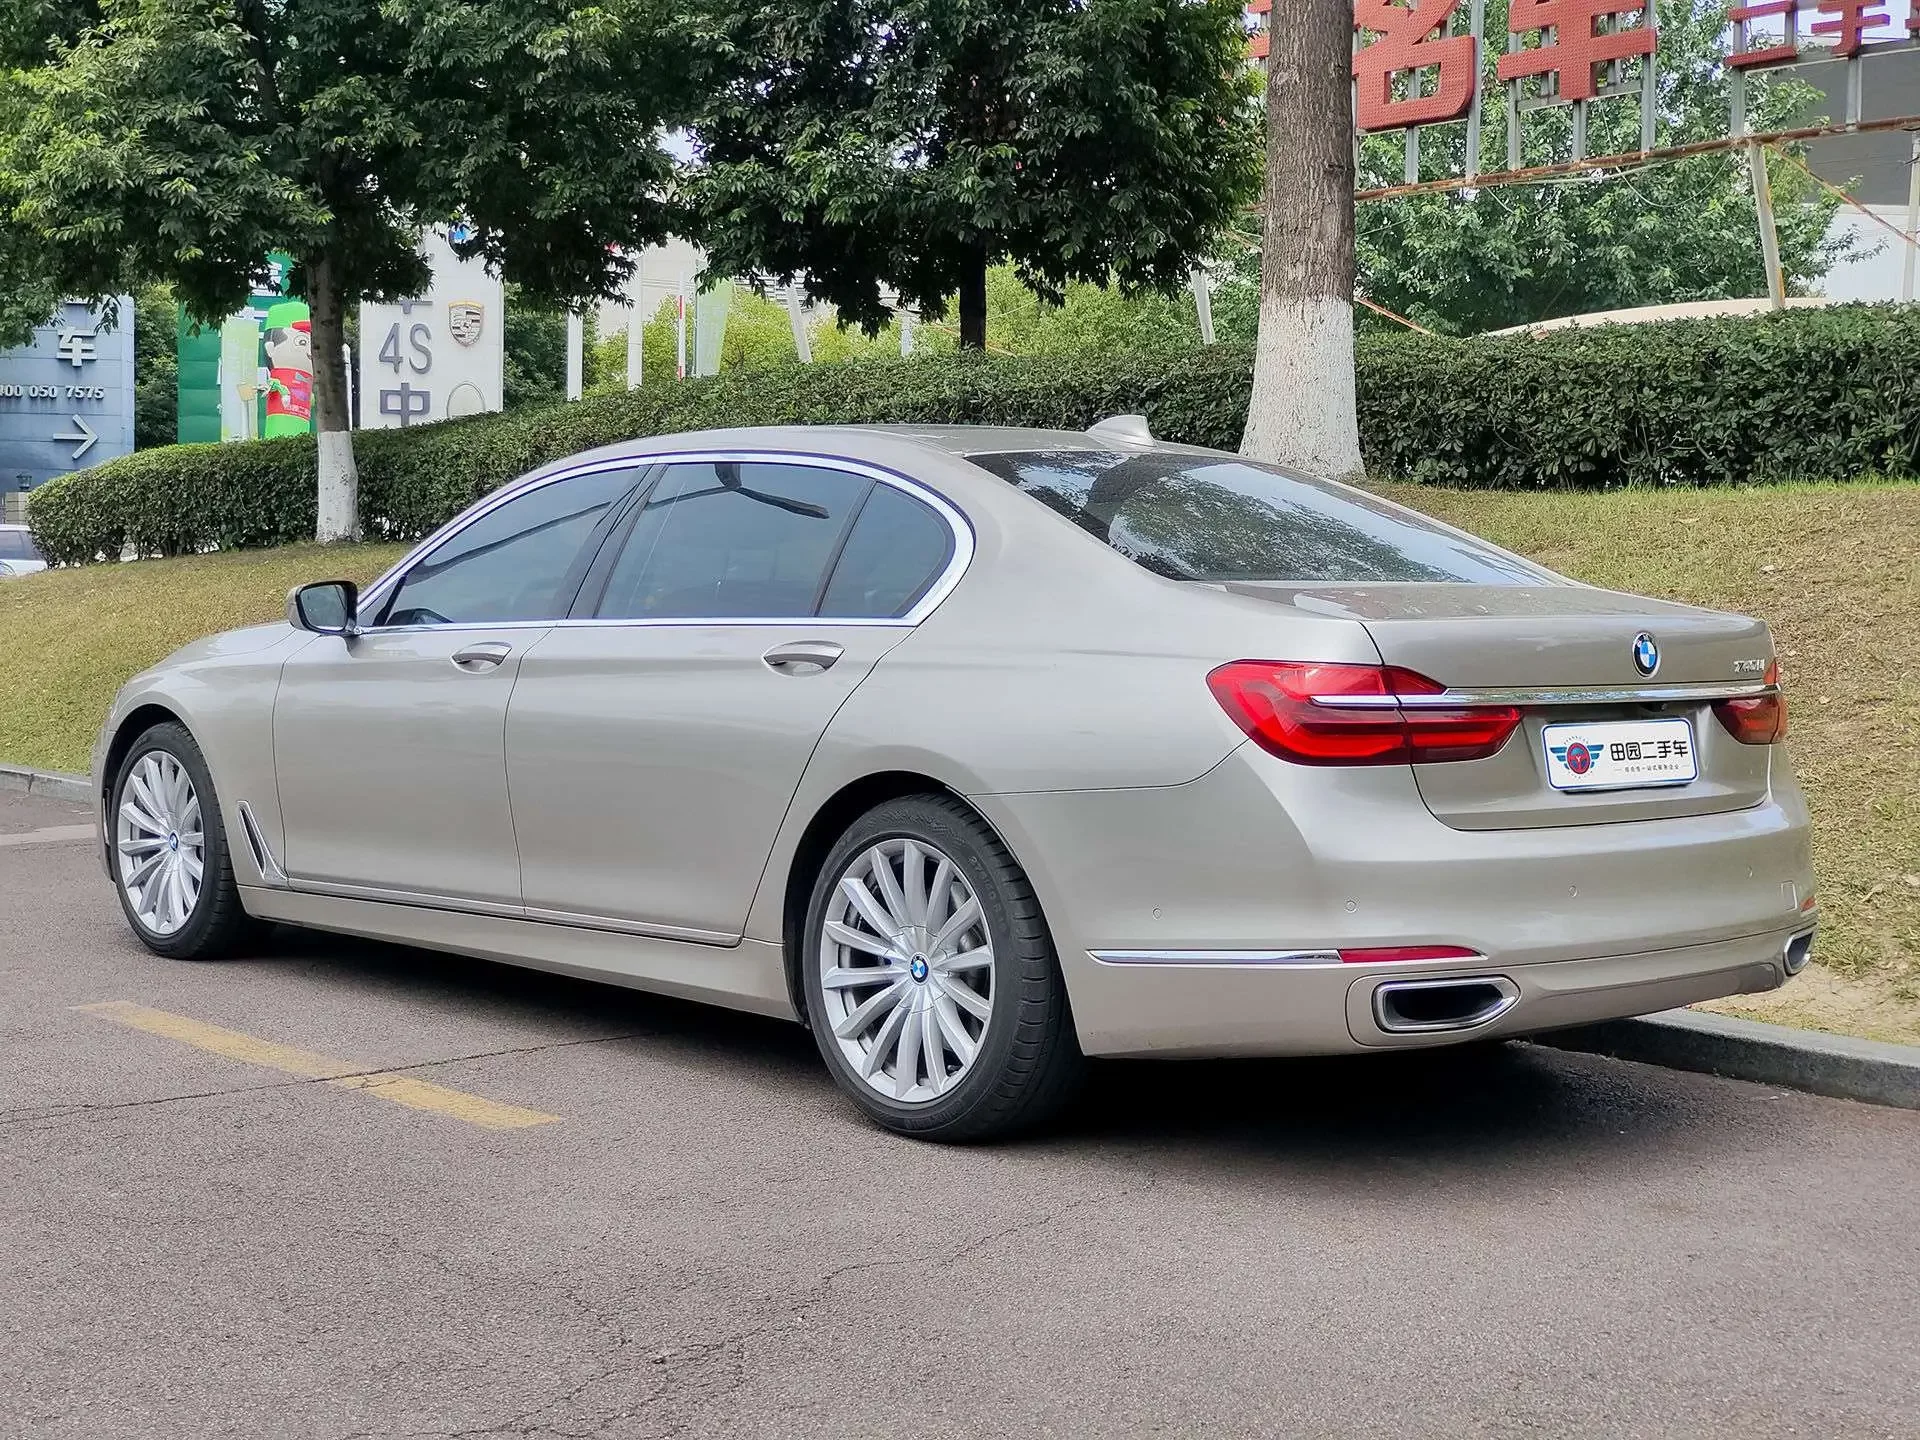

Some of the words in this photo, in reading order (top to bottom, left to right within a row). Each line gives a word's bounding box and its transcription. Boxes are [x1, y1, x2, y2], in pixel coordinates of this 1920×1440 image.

[56, 326, 98, 367] 车
[378, 322, 433, 375] 4S
[29, 385, 58, 399] 050
[65, 385, 105, 400] 7575
[379, 382, 431, 426] 中
[1610, 740, 1688, 761] 田园二手车
